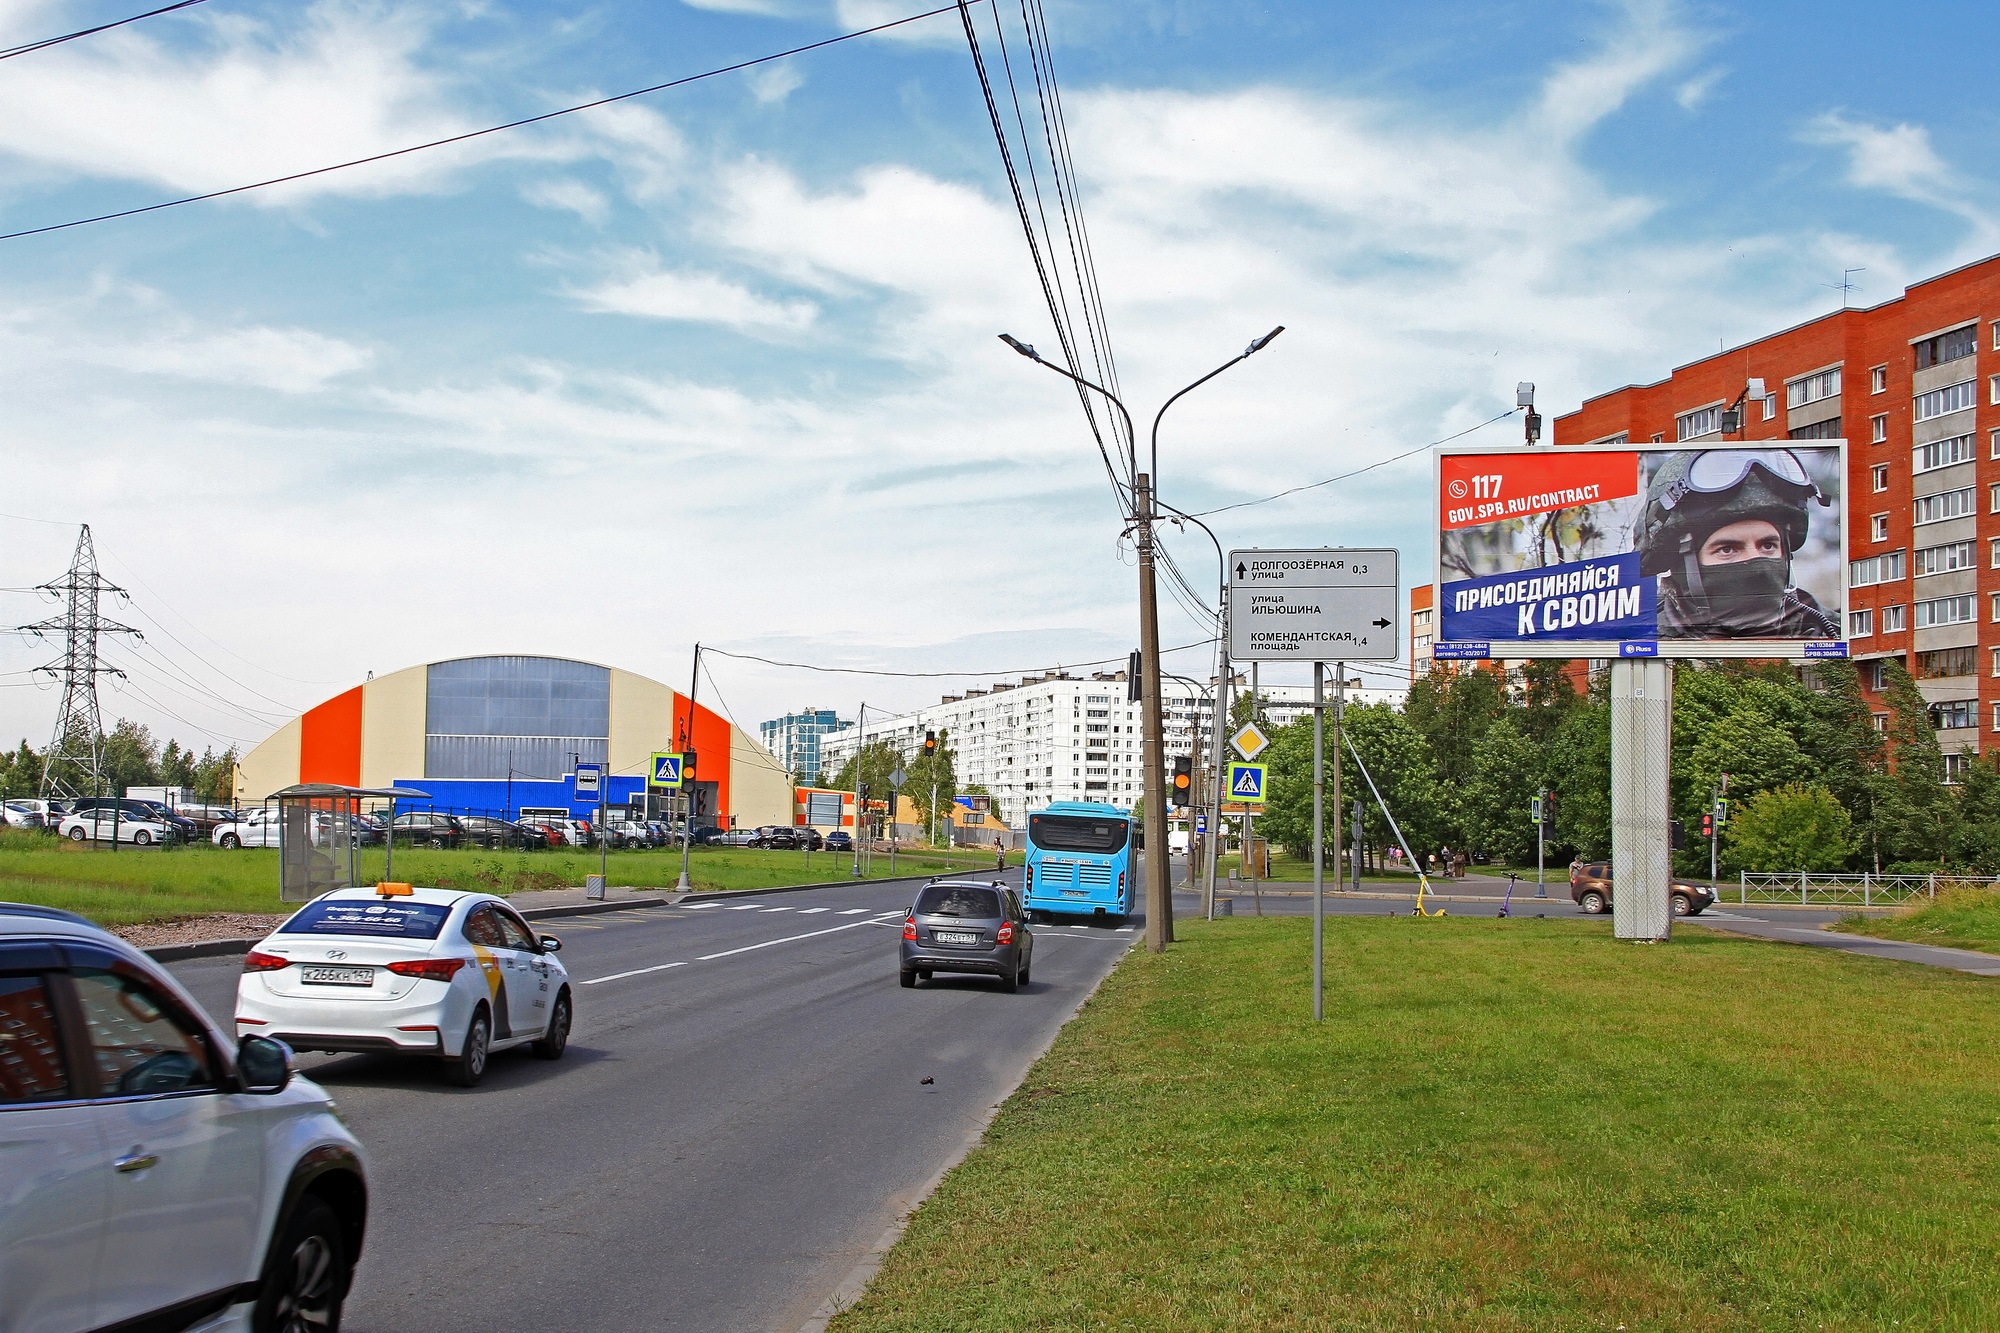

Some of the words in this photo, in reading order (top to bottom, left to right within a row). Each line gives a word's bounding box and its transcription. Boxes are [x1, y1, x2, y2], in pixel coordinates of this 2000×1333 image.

[1471, 475, 1503, 499] 117
[1448, 484, 1600, 523] GOV.SPB.RU/CONTRACT
[1251, 559, 1344, 570] ДОЛГООЗЁРНАЯ
[1251, 571, 1284, 581] улица
[1352, 565, 1368, 576] 0,3
[1455, 564, 1620, 613] ПРИСОЕДИНЯЙСЯ
[1251, 595, 1284, 605] улица
[1251, 605, 1322, 615] ИЛЬЮШИНА
[1518, 603, 1537, 636] К
[1543, 585, 1641, 632] СВОИМ
[1250, 632, 1352, 643] КОМЕНДАНТСКАЯ
[1352, 637, 1368, 647] 1,4
[1250, 642, 1300, 651] площадь
